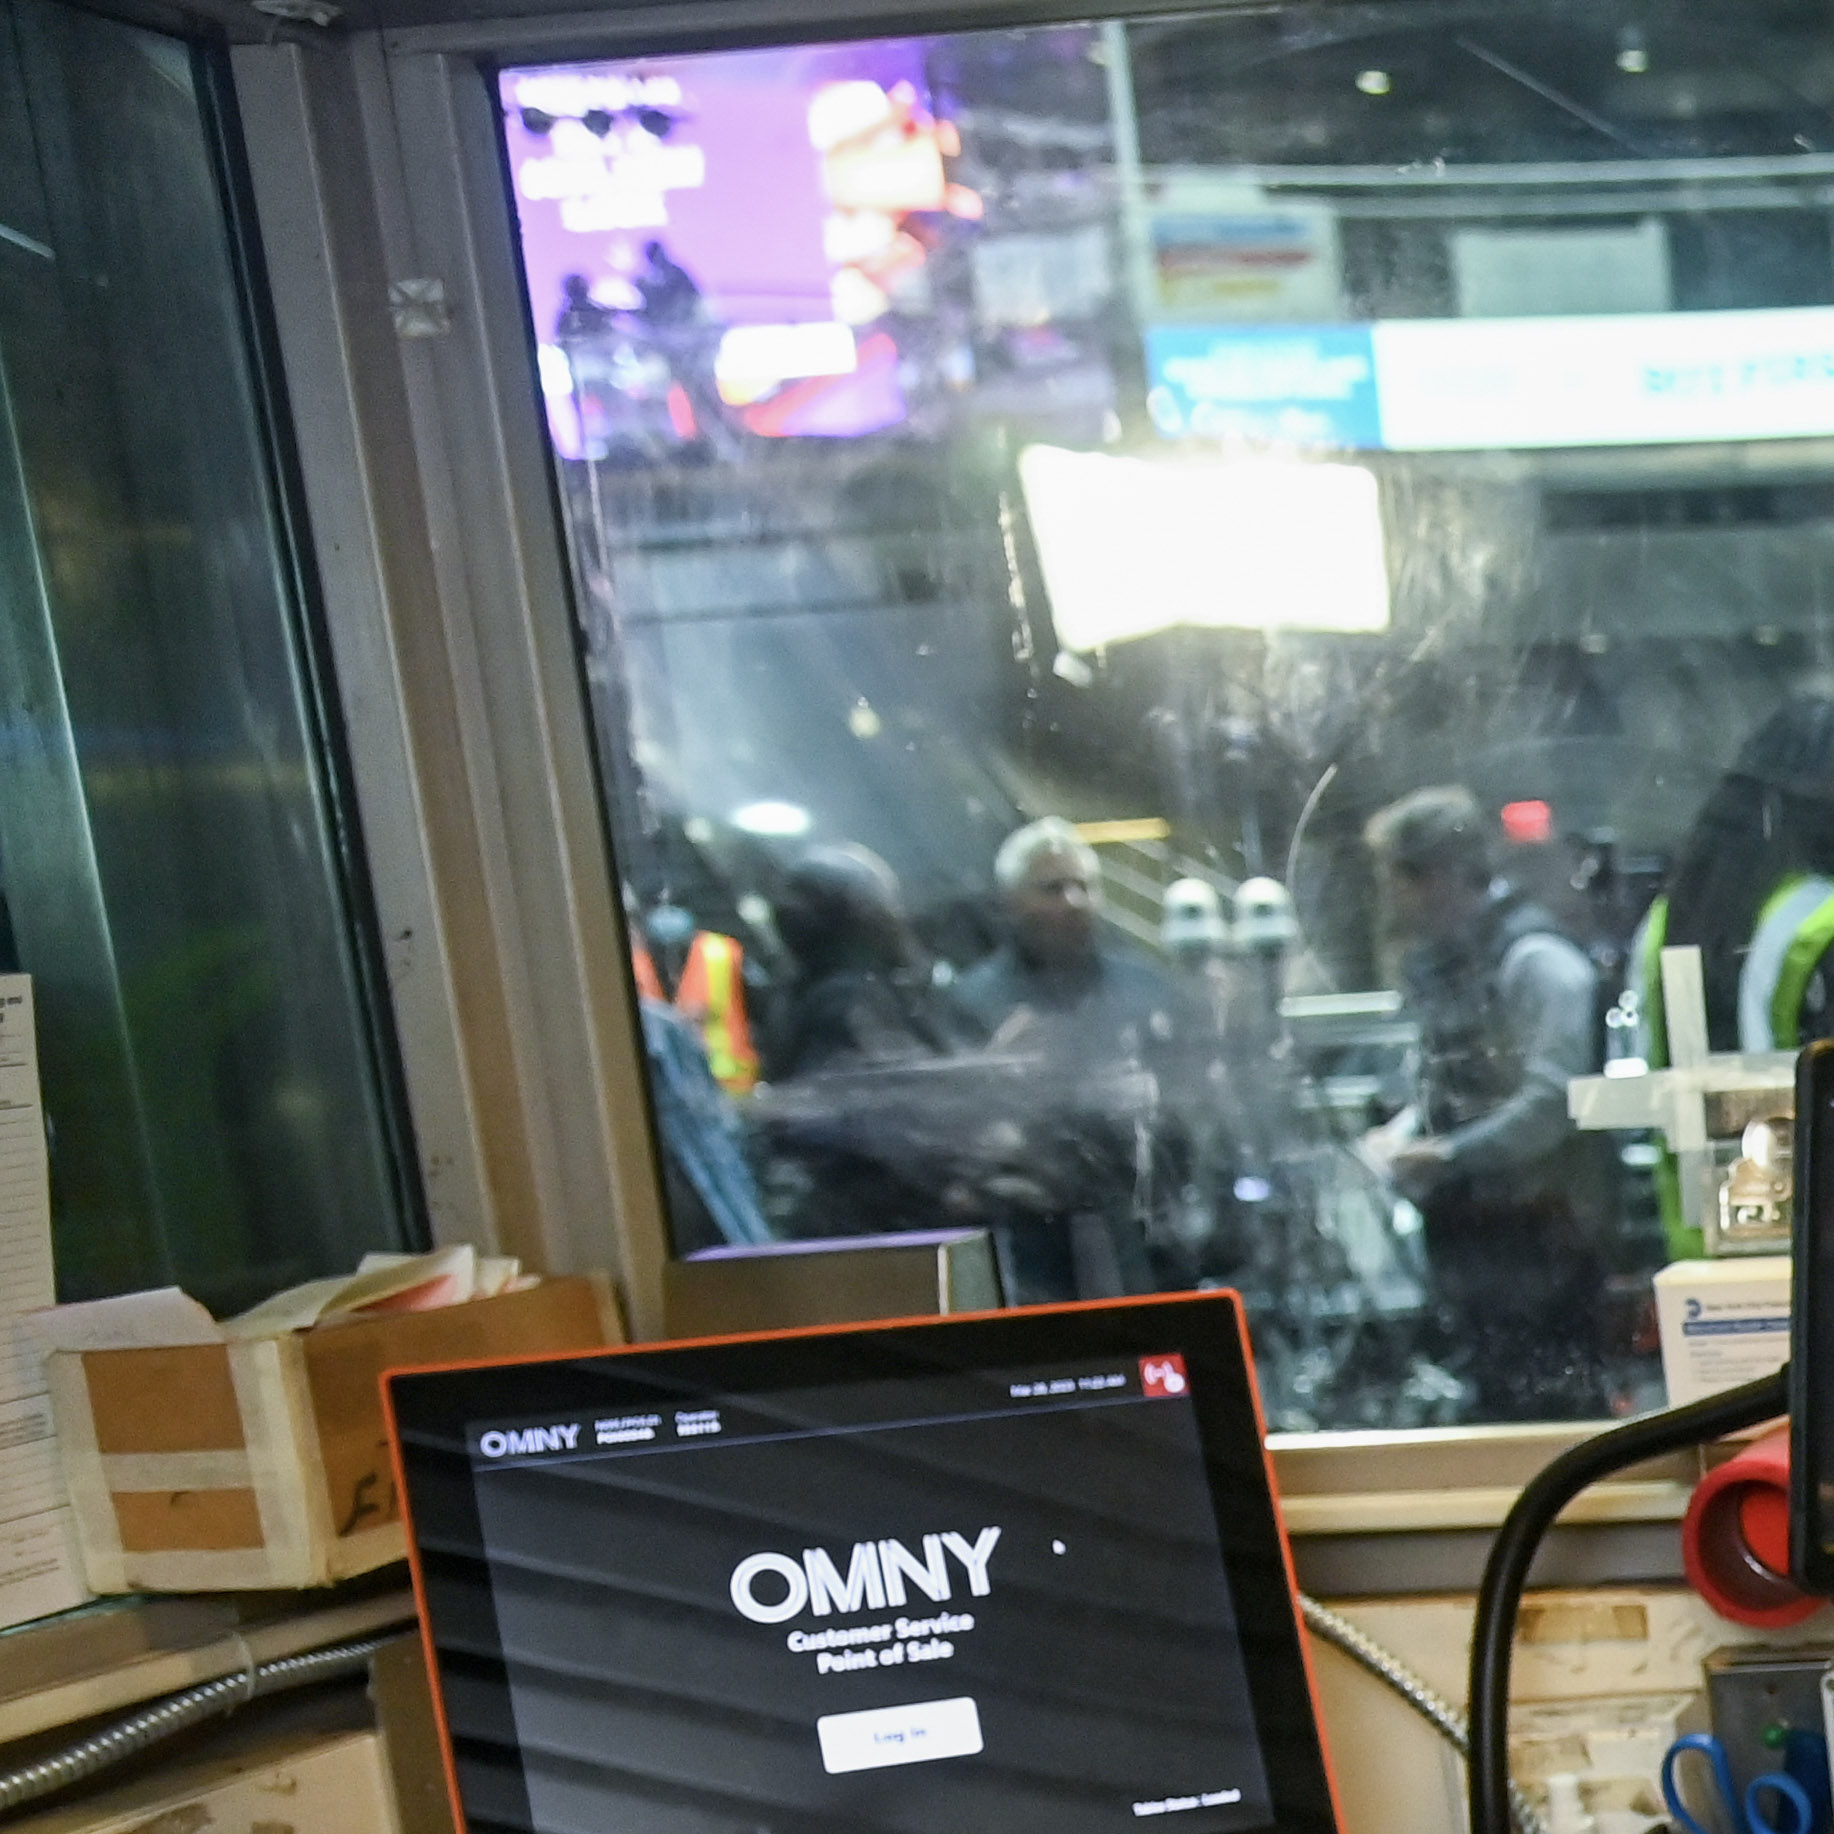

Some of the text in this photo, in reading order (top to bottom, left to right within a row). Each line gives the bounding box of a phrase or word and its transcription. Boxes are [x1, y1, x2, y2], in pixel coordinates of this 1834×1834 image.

[480, 1423, 582, 1458] OMNY
[730, 1525, 1001, 1624] OMNY
[787, 1611, 975, 1653] Customer Service
[816, 1637, 954, 1675] Point of Sale
